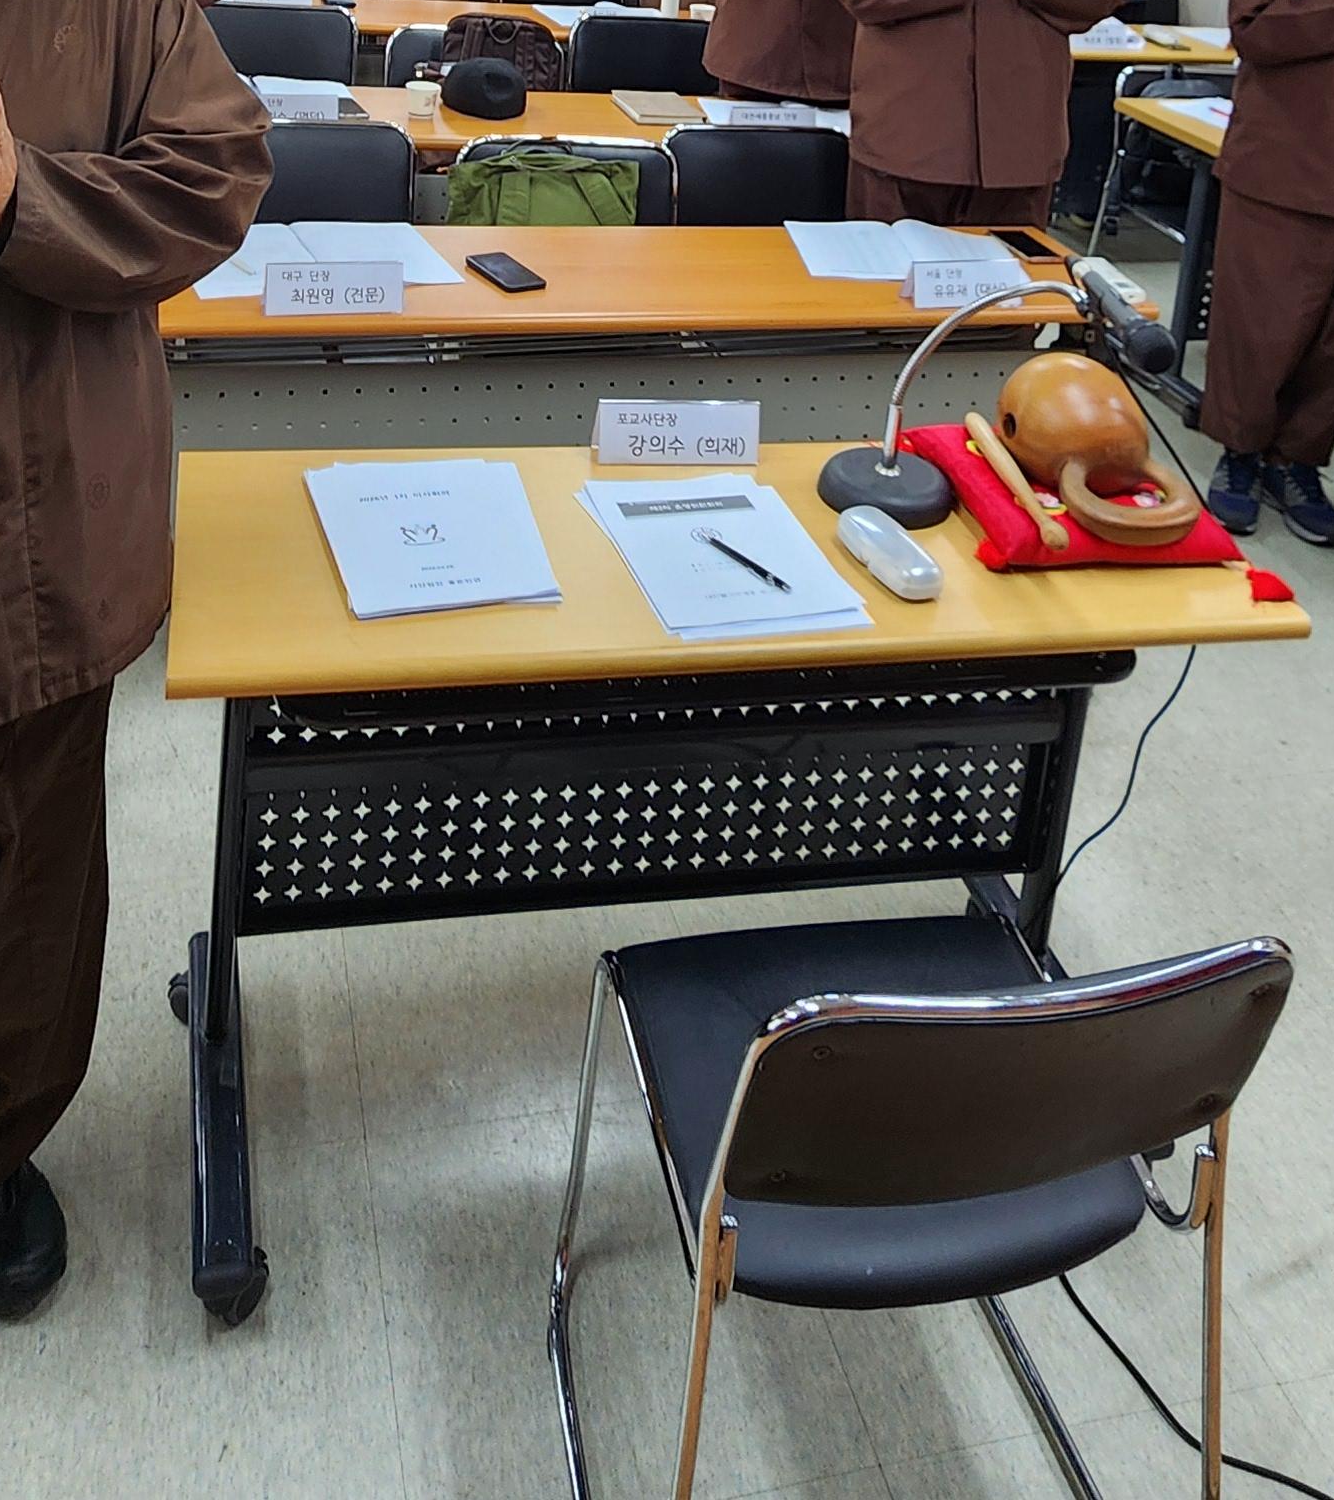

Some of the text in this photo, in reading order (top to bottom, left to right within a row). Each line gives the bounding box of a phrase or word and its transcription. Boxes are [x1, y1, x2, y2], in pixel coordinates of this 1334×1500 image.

[282, 270, 330, 282] 대구 단장
[291, 288, 334, 304] 최원영
[617, 413, 678, 427] 포교사단장
[628, 435, 685, 457] 강의수
